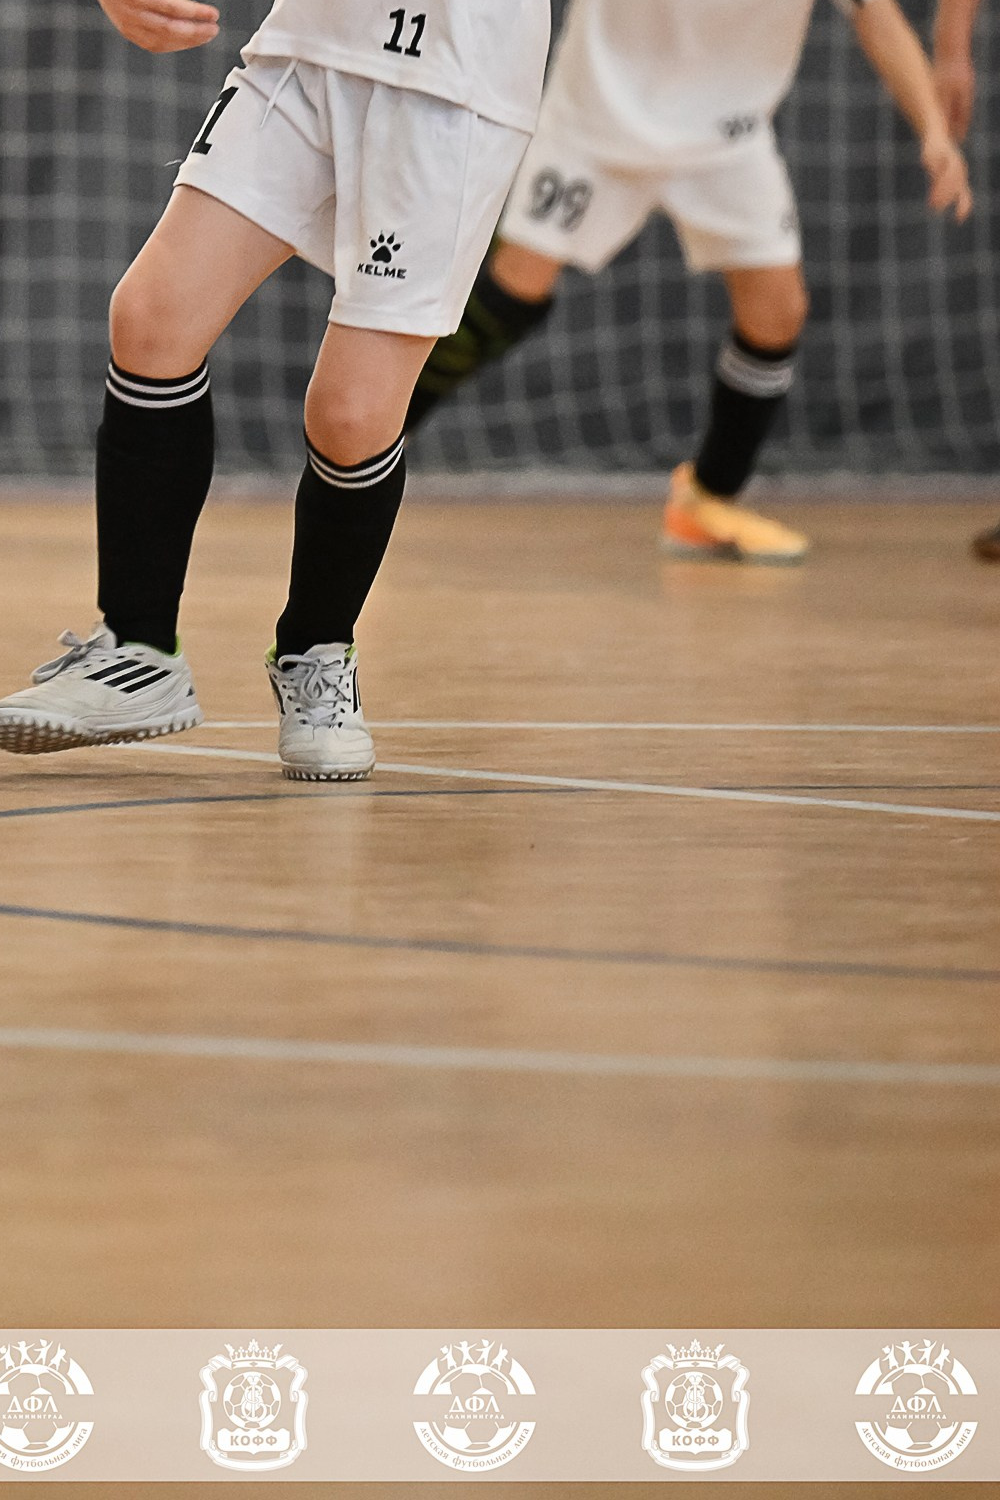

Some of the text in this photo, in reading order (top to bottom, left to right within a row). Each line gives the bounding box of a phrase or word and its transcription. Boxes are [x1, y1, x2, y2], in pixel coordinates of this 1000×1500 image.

[383, 8, 426, 58] 11
[528, 166, 593, 232] 99
[357, 263, 407, 279] KELME
